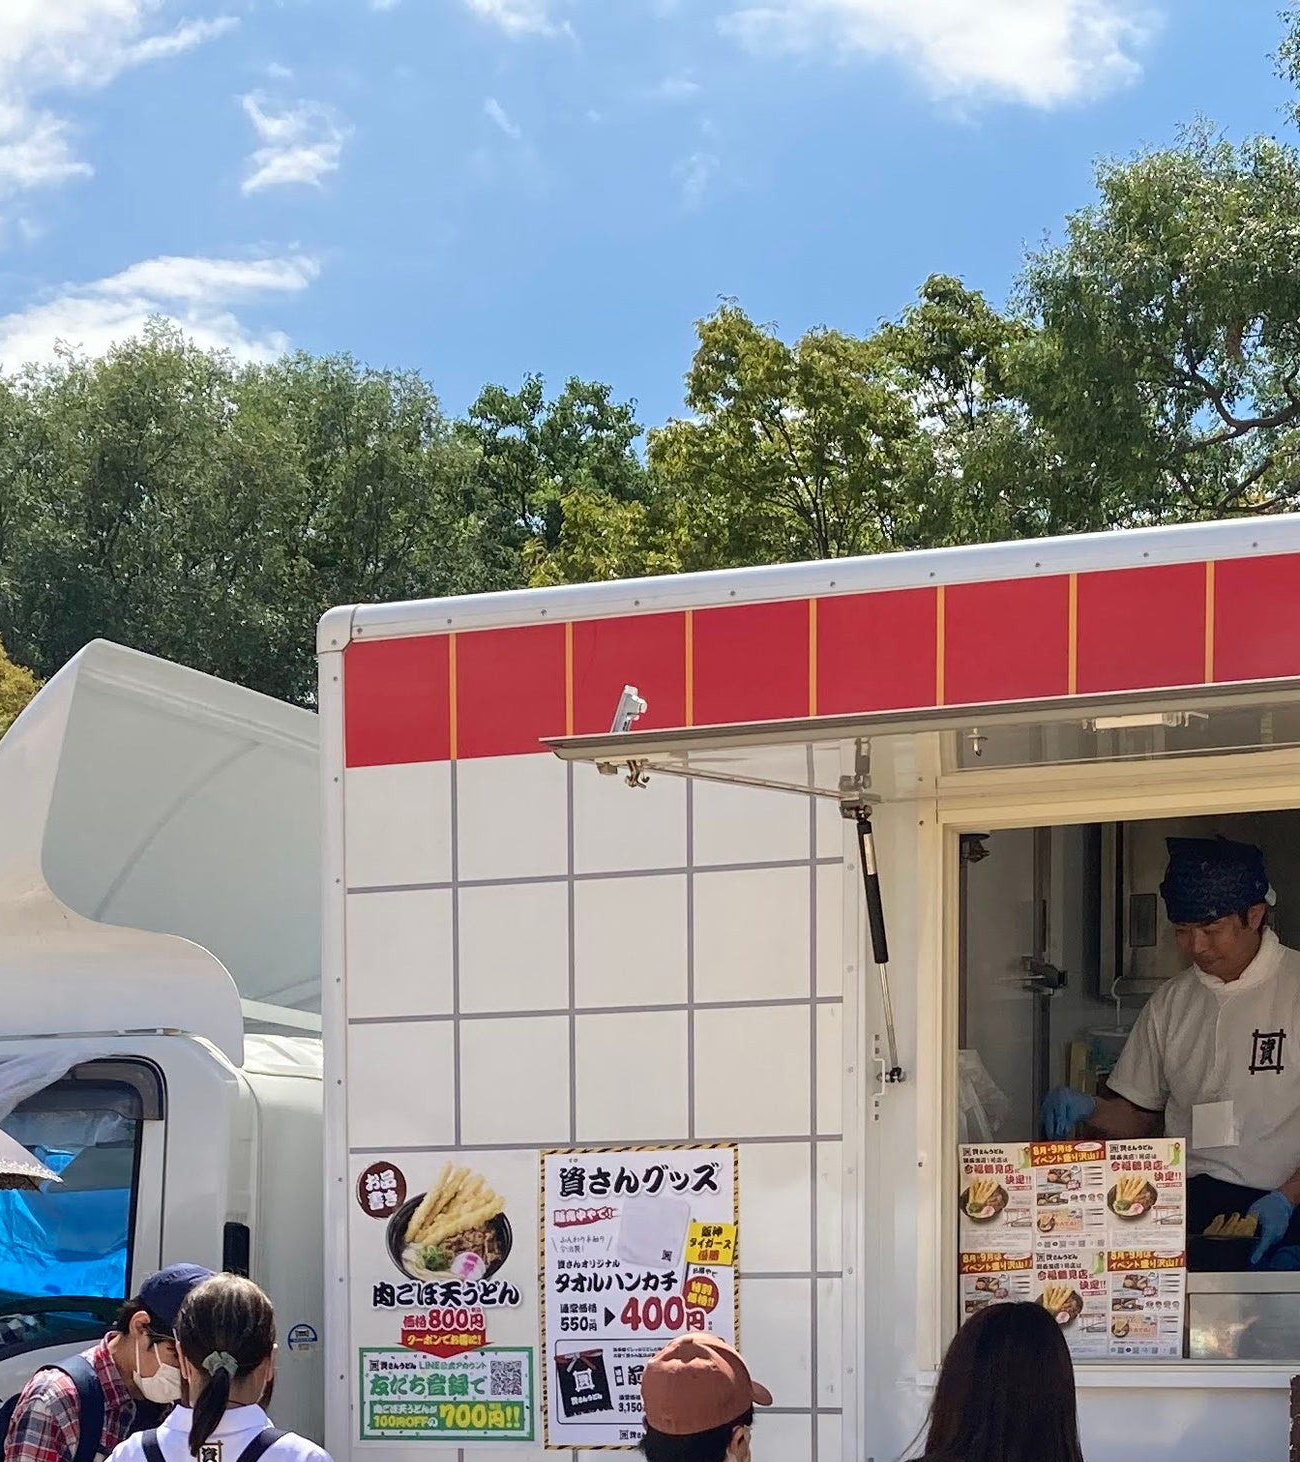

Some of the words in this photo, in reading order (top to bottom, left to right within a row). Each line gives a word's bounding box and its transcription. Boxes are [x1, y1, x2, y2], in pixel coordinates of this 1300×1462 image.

[559, 1162, 719, 1197] 資さんグッズ
[689, 1237, 732, 1250] タイガース
[373, 1281, 520, 1307] 肉ごぼ天うどん
[555, 1271, 678, 1293] タオルハンカチ
[560, 1316, 597, 1331] 550円
[620, 1296, 705, 1331] 400円
[370, 1373, 487, 1397] 友だち登録で
